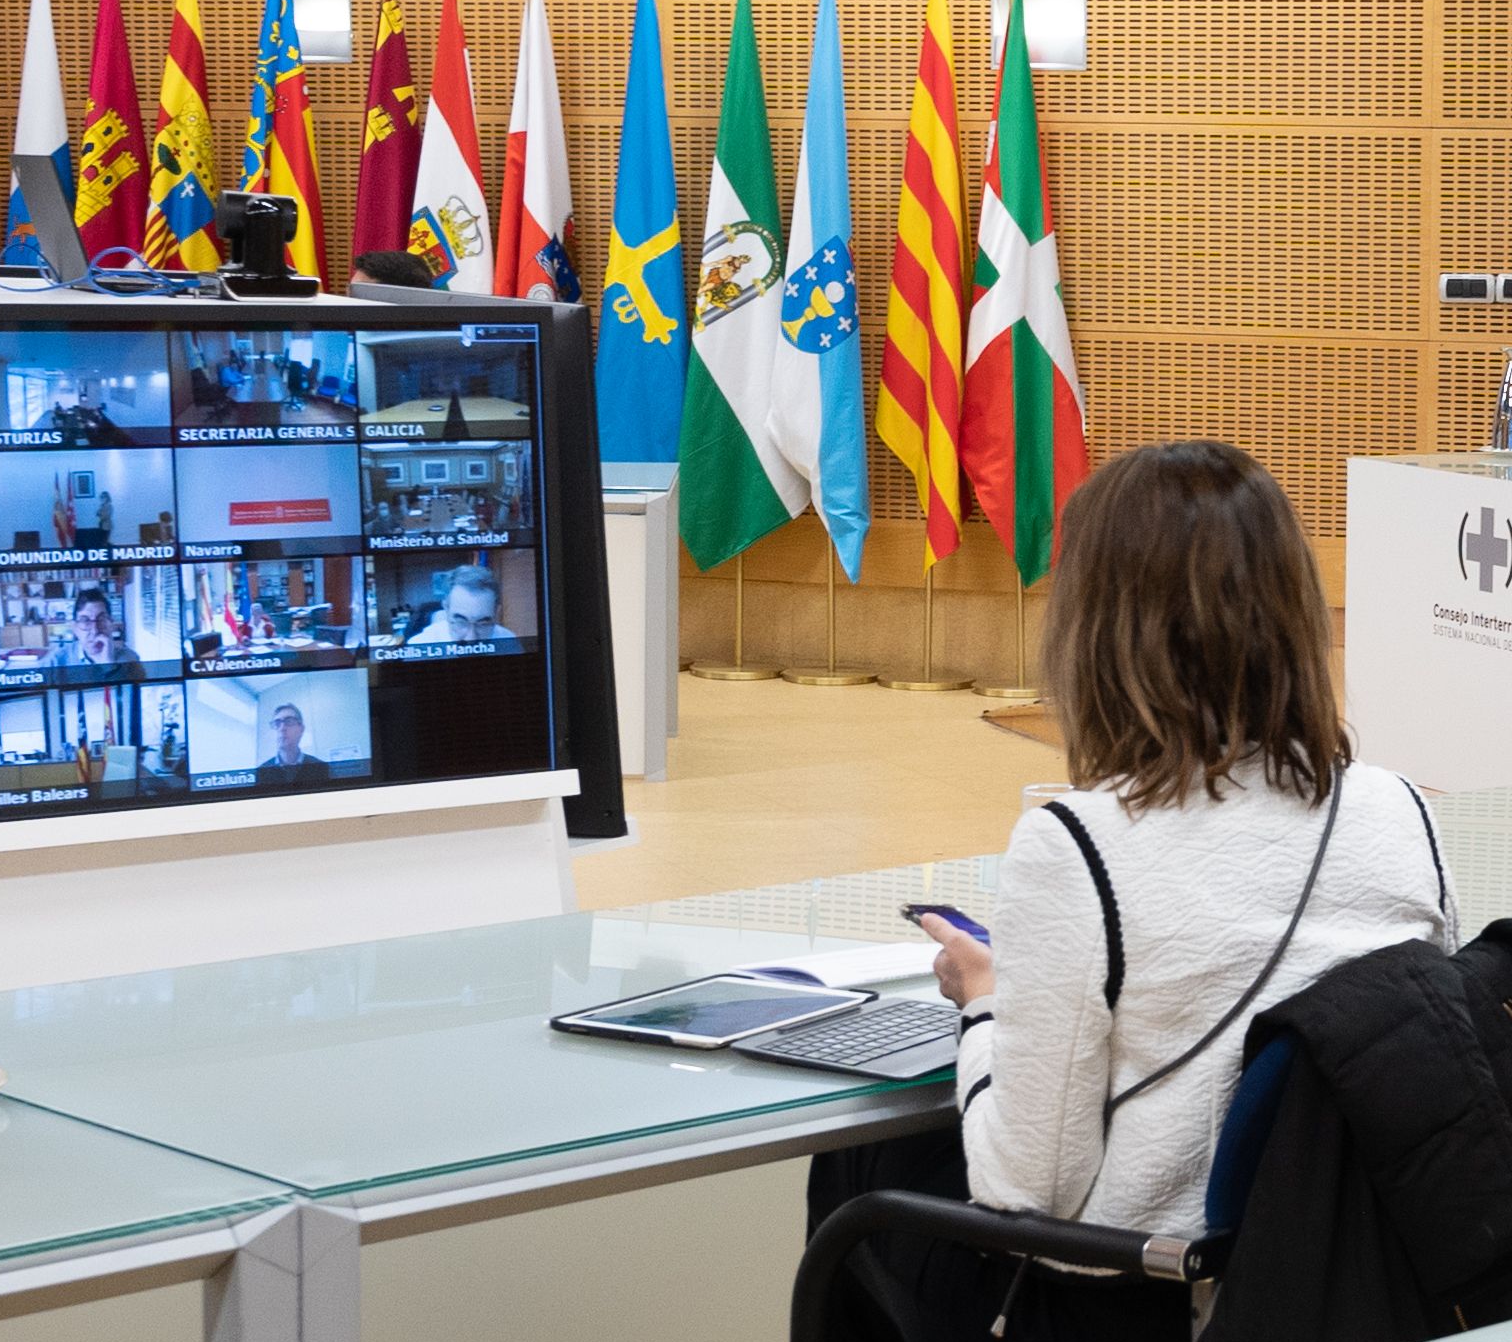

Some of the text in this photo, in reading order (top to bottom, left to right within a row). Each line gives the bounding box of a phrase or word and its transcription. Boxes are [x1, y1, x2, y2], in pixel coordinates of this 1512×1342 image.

[179, 426, 275, 442] SECRETARIA
[277, 425, 343, 440] GENERAL
[365, 424, 425, 438] GALICIA
[370, 531, 509, 549] Ministerio de Sanidad
[87, 548, 109, 563] DE
[112, 545, 175, 561] MADRID
[185, 542, 243, 558] Navarra
[1433, 603, 1469, 626] Consejo
[1433, 623, 1463, 640] SISTEMA
[1464, 630, 1502, 650] NACIONAL
[375, 641, 496, 661] Castilla-La Mancha
[190, 656, 282, 674] C.Valenciana
[196, 770, 256, 789] cataluña
[31, 788, 89, 805] Balears
